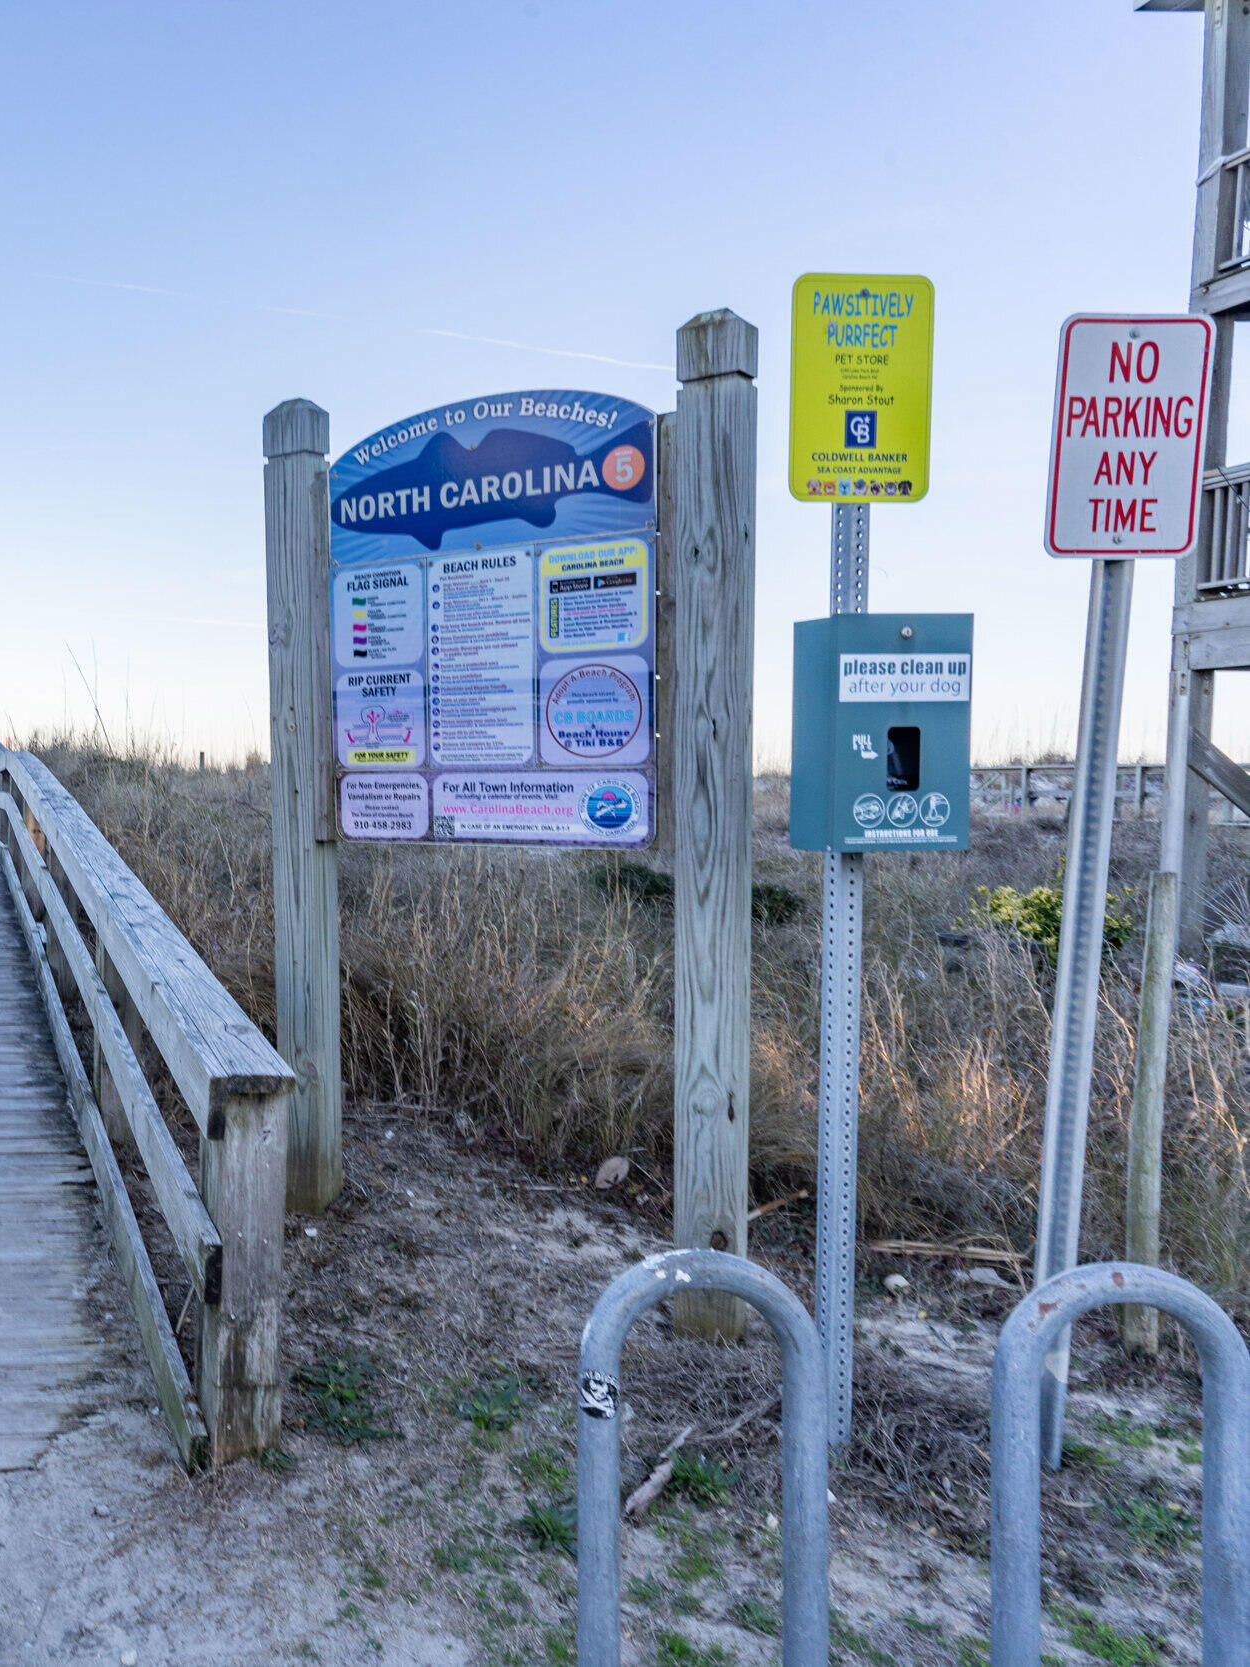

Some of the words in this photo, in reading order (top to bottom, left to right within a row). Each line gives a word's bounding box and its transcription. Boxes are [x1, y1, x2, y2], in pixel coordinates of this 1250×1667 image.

[813, 291, 914, 318] PAWSITIVELY
[827, 323, 898, 348] PURRFECT
[835, 355, 853, 365] PET
[856, 354, 889, 366] STORE
[1109, 341, 1159, 383] NO
[828, 394, 863, 406] Sharon
[867, 395, 894, 406] Stout
[1066, 396, 1194, 438] PARKING
[353, 416, 438, 466] Welcome
[445, 409, 466, 427] to
[473, 401, 513, 420] Our
[519, 398, 619, 429] Beaches!
[812, 452, 863, 462] COLDWELL
[868, 453, 907, 462] BANKER
[615, 456, 634, 483] 5
[833, 466, 856, 474] COAST
[859, 466, 901, 474] ADVANTAGE
[1094, 451, 1158, 486] ANY
[340, 485, 431, 524] NORTH
[440, 460, 600, 508] CAROLINA
[1089, 498, 1158, 532] TIME
[549, 550, 595, 564] DOWNLOAD
[598, 548, 615, 558] OUR
[443, 560, 478, 573] BEACH
[482, 556, 517, 569] RULES
[561, 561, 597, 571] CAROLINA
[600, 558, 624, 567] BEACH
[347, 580, 370, 592] FLAG
[372, 575, 409, 589] SIGNAL
[844, 660, 896, 676] please
[900, 660, 943, 676] clean
[948, 661, 967, 676] up
[348, 676, 364, 687] RIP
[366, 673, 411, 685] CURRENT
[579, 669, 607, 678] Beach
[609, 672, 635, 702] Program
[849, 678, 885, 693] after
[890, 681, 926, 696] your
[930, 678, 962, 696] dog
[362, 686, 396, 697] SAFETY
[554, 711, 573, 725] CB
[577, 709, 634, 723] BOARDS
[558, 730, 592, 739] Beach
[596, 729, 630, 738] House
[853, 734, 872, 745] PULL
[576, 739, 595, 747] Tiki
[599, 739, 623, 747] B&B
[355, 751, 366, 759] FOR
[443, 782, 460, 792] For
[462, 782, 476, 792] All
[479, 782, 507, 793] Town
[510, 782, 574, 793] Information
[443, 803, 573, 817] www.CarolinaBeach.org
[864, 829, 911, 838] INSTRUCTIONS
[913, 829, 925, 837] FOR
